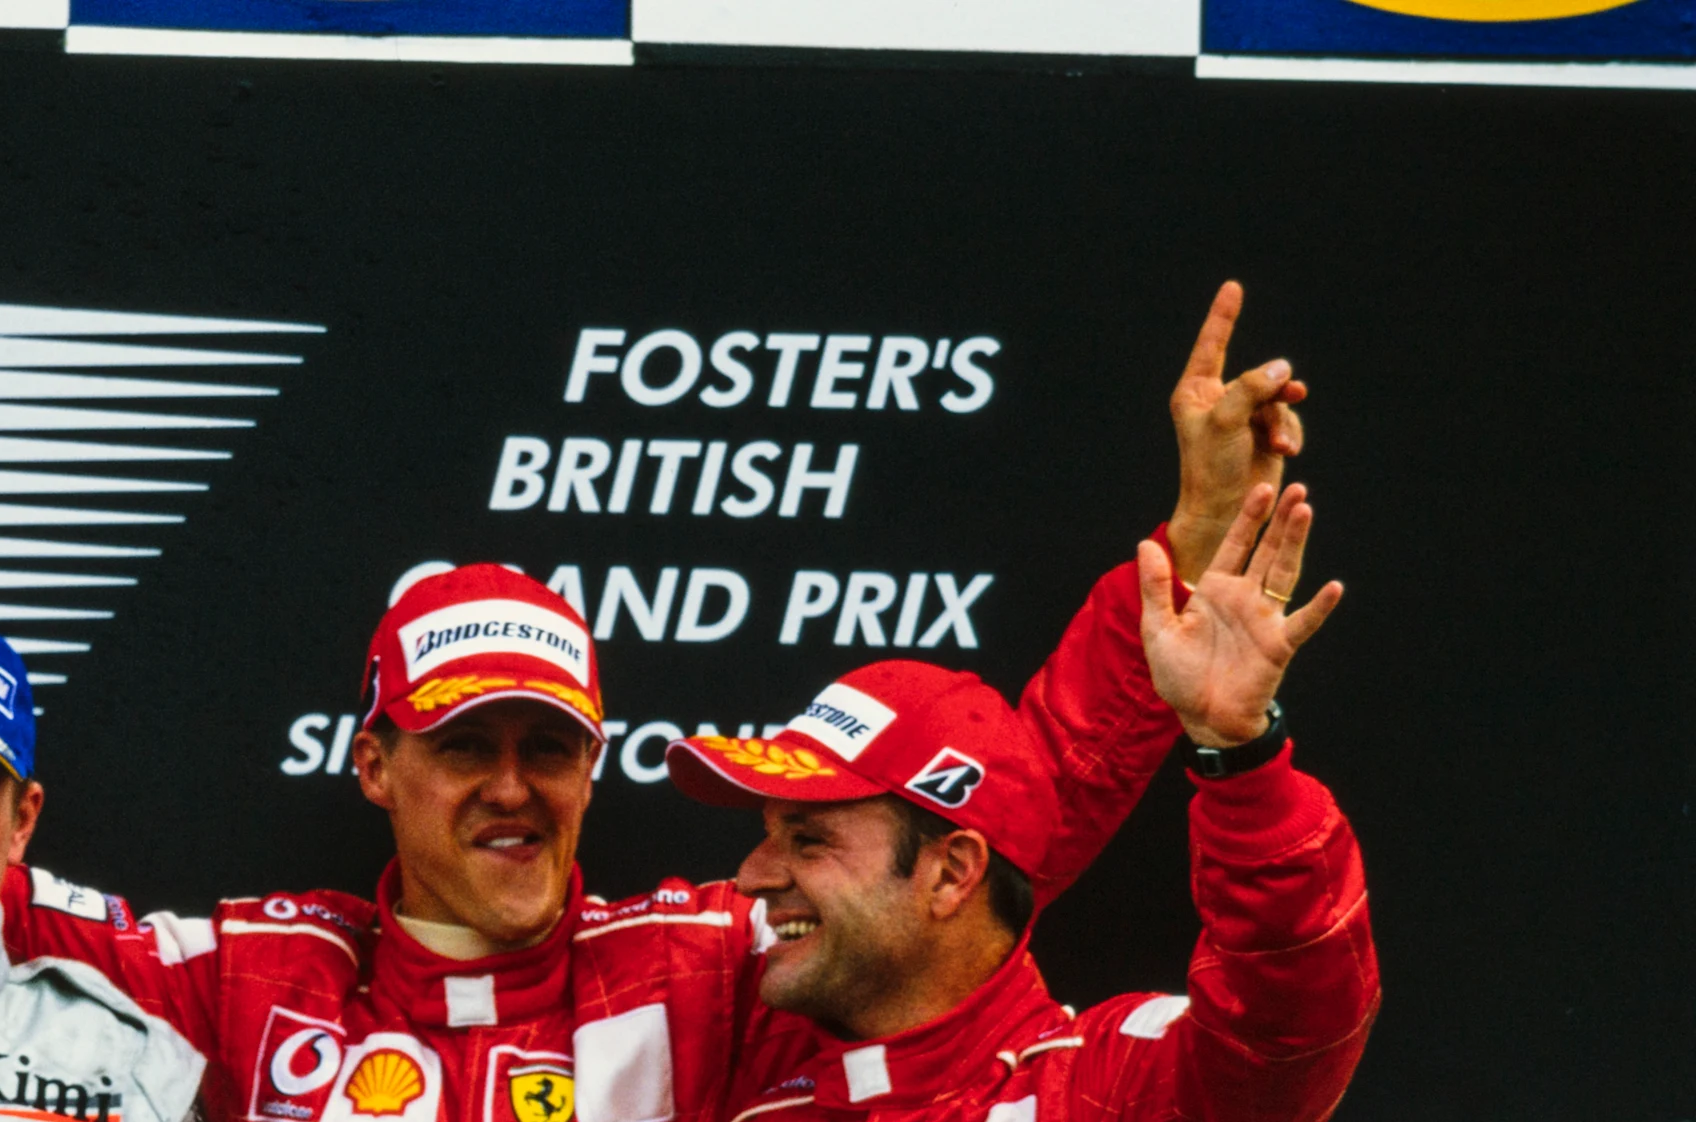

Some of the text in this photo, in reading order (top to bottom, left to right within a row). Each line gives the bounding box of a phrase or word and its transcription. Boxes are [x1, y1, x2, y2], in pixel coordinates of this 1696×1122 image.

[564, 328, 1001, 414] FOSTER'S
[488, 436, 860, 518] BRITISH
[388, 562, 995, 649] AND PRIX
[414, 620, 583, 665] BRIDGESTONE
